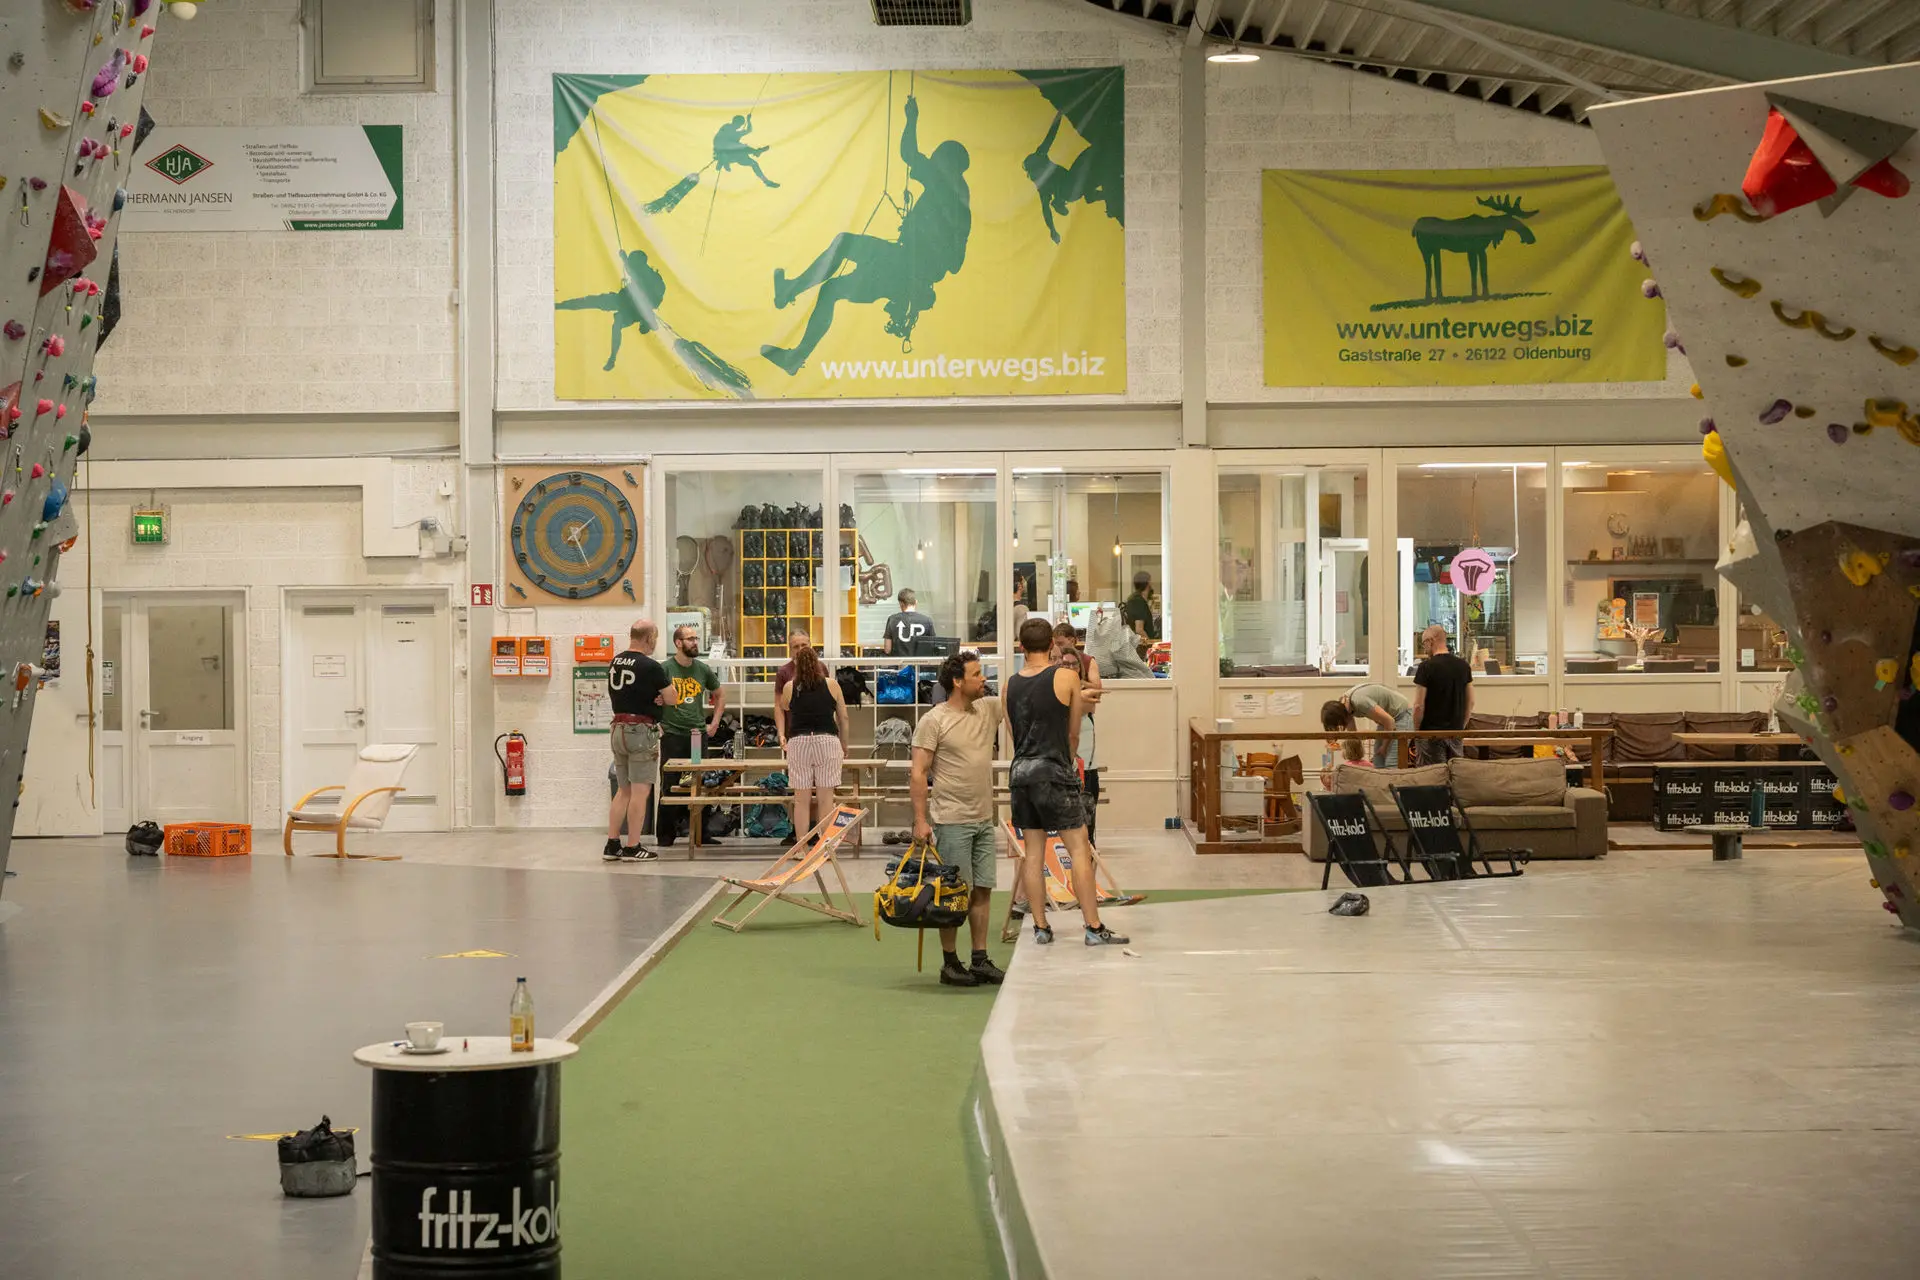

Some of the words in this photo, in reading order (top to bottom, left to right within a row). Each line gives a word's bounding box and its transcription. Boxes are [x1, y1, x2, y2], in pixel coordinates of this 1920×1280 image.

[166, 154, 192, 176] HJA
[126, 192, 187, 204] HERMANN
[189, 192, 233, 206] JANSEN
[1336, 313, 1594, 342] www.unterwegs.biz
[1338, 347, 1422, 363] Gaststraße
[1428, 347, 1446, 362] 27
[1465, 347, 1507, 362] 26122
[1513, 345, 1592, 363] Oldenburg
[820, 351, 1107, 382] www.unterwegs.biz
[612, 657, 636, 667] TEAM
[1666, 782, 1702, 795] fritz-kola
[1714, 781, 1750, 793] fritz-kola
[1763, 781, 1798, 794] fritz-kola
[1409, 810, 1450, 828] fritz-kola
[1667, 812, 1702, 825] fritz-kola
[1714, 811, 1750, 824] fritz-kola
[1763, 810, 1798, 823] fritz-kola
[1327, 817, 1366, 836] fritz-kola
